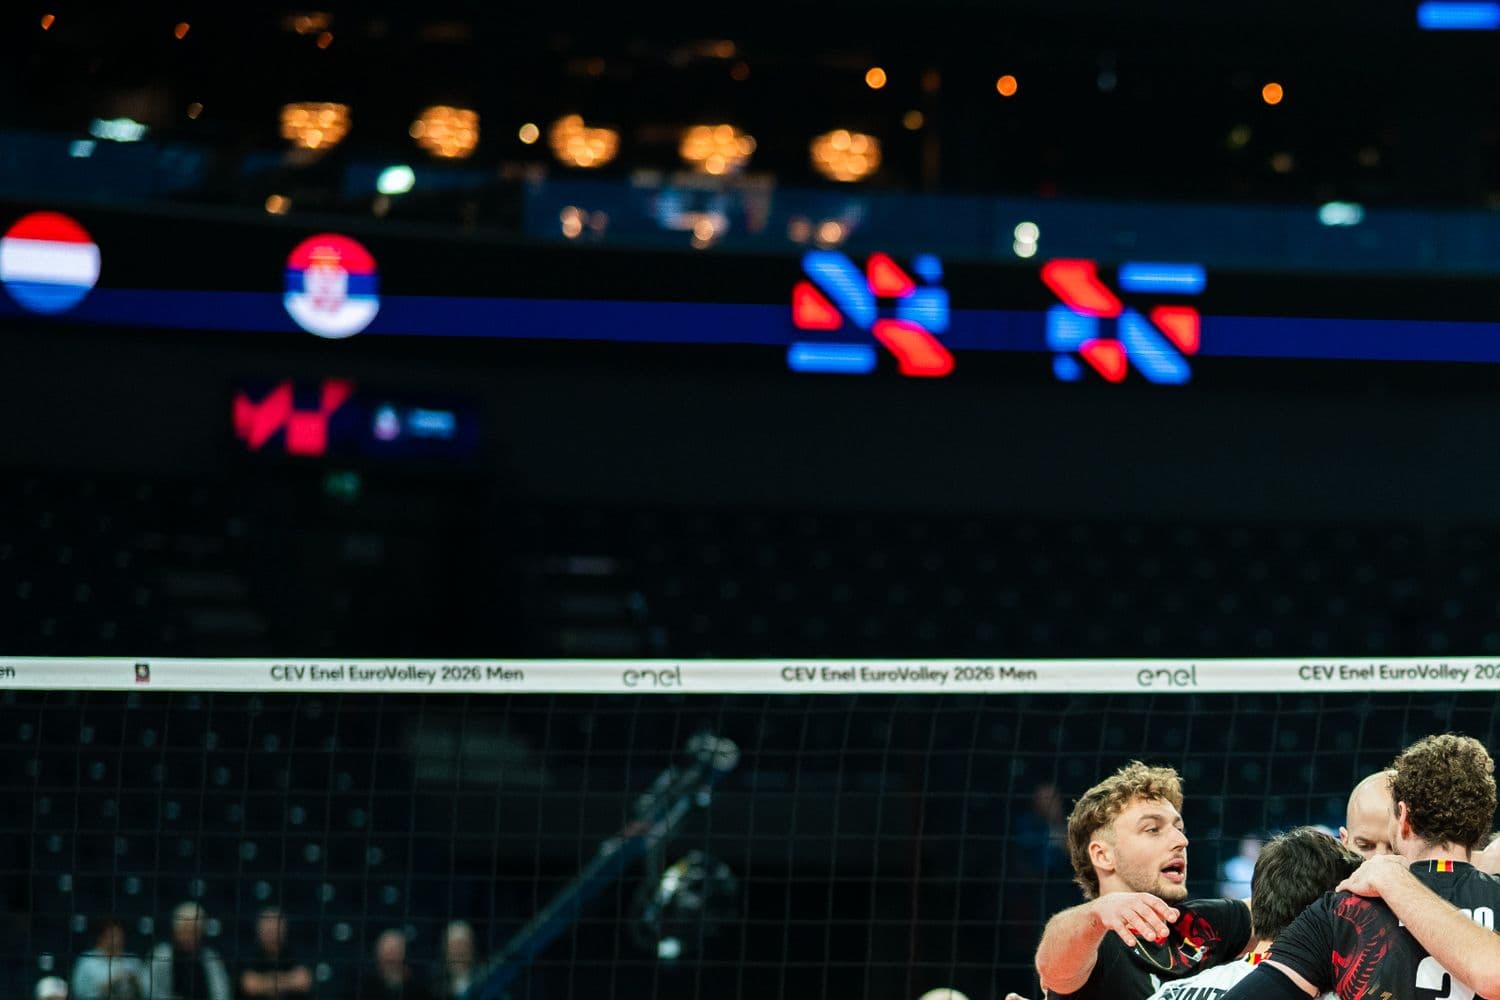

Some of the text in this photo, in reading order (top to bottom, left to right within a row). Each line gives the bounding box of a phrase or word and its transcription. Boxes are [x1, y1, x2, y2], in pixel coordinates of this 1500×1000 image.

[0, 665, 16, 679] en
[269, 665, 525, 684] CEV Enel EuroVolley 2026 Men
[622, 665, 682, 686] enel
[780, 666, 1038, 685] CEV Enel EuroVolley 2026 Men
[1136, 664, 1197, 686] enel
[1297, 665, 1335, 681] CEV
[1338, 664, 1375, 681] Enel
[1378, 663, 1470, 683] EuroVolley
